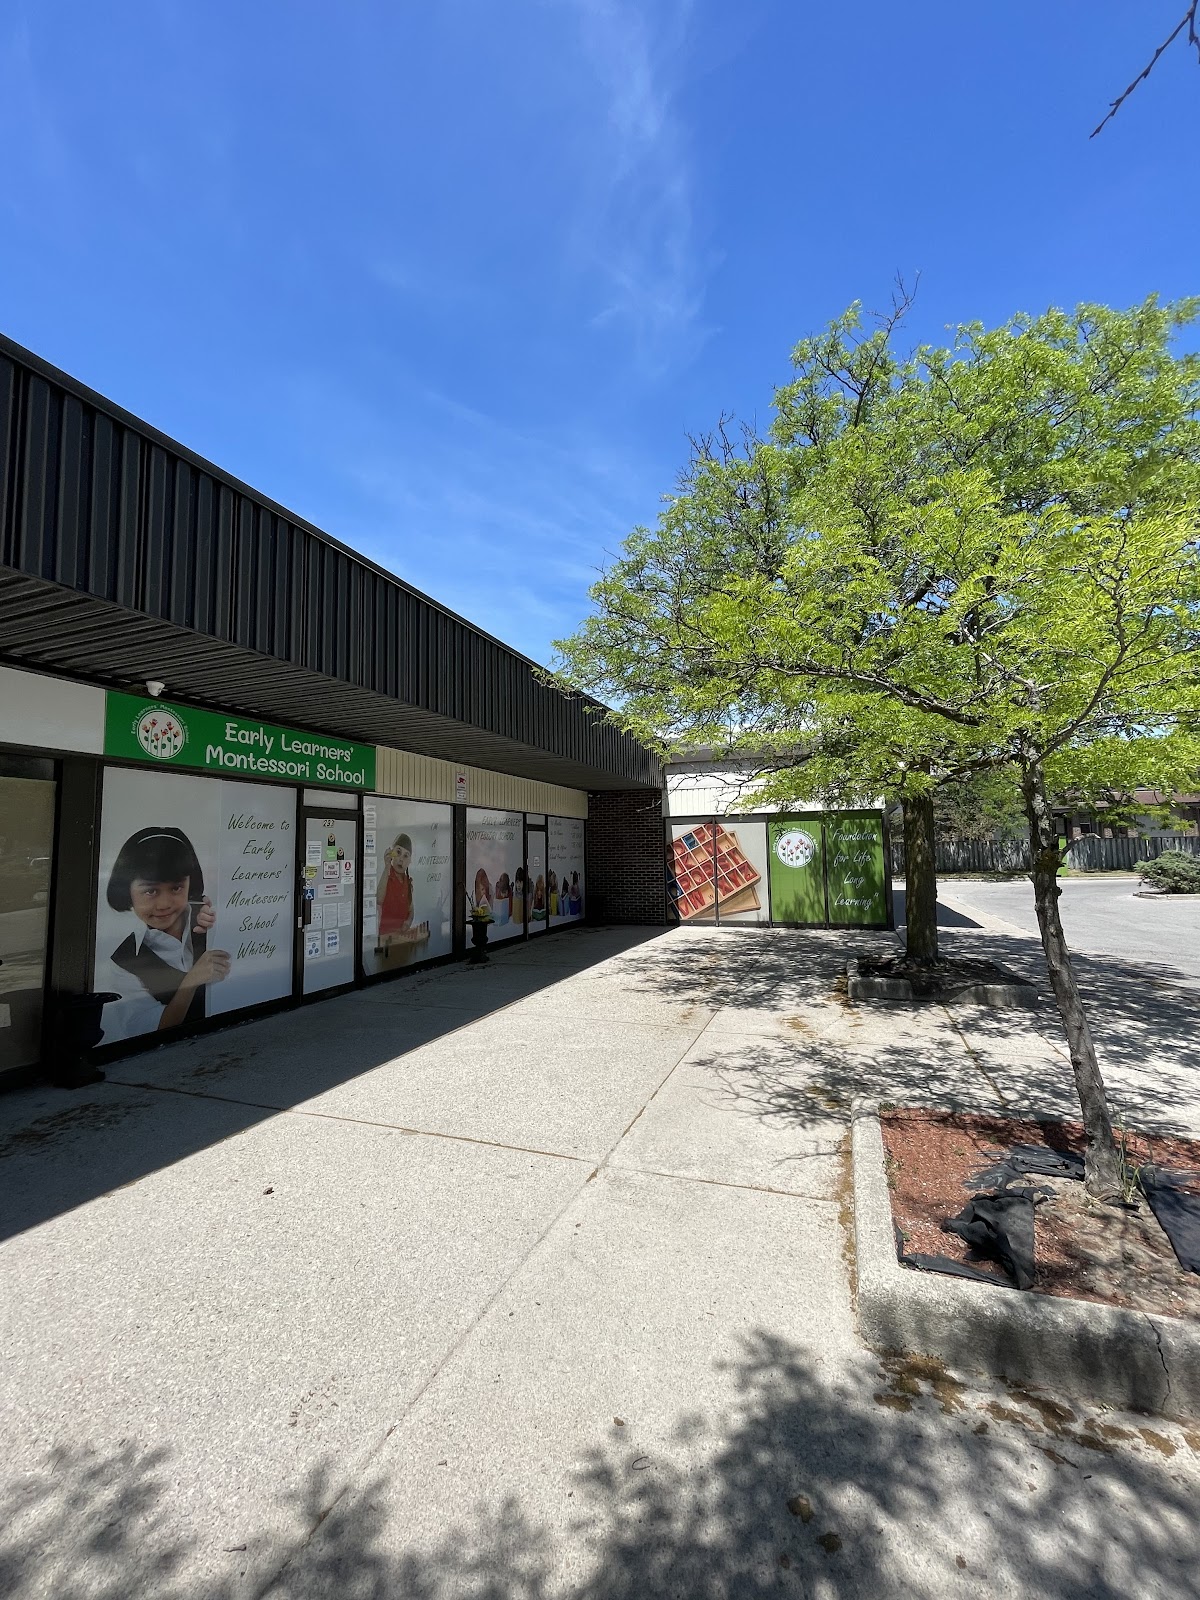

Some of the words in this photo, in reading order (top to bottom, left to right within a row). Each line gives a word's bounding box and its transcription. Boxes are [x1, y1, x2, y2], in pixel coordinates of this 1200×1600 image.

[224, 722, 274, 754] Early
[281, 733, 354, 763] Learners'
[205, 744, 311, 778] Montessori
[316, 763, 366, 786] School
[227, 813, 276, 830] Welcome
[280, 819, 291, 831] to
[242, 839, 276, 860] Early
[833, 849, 850, 867] for
[853, 849, 872, 867] Life
[231, 864, 288, 881] Learners'
[843, 871, 865, 889] Long
[225, 890, 290, 909] Montessori
[238, 912, 279, 932] School
[236, 939, 277, 960] Whitby
